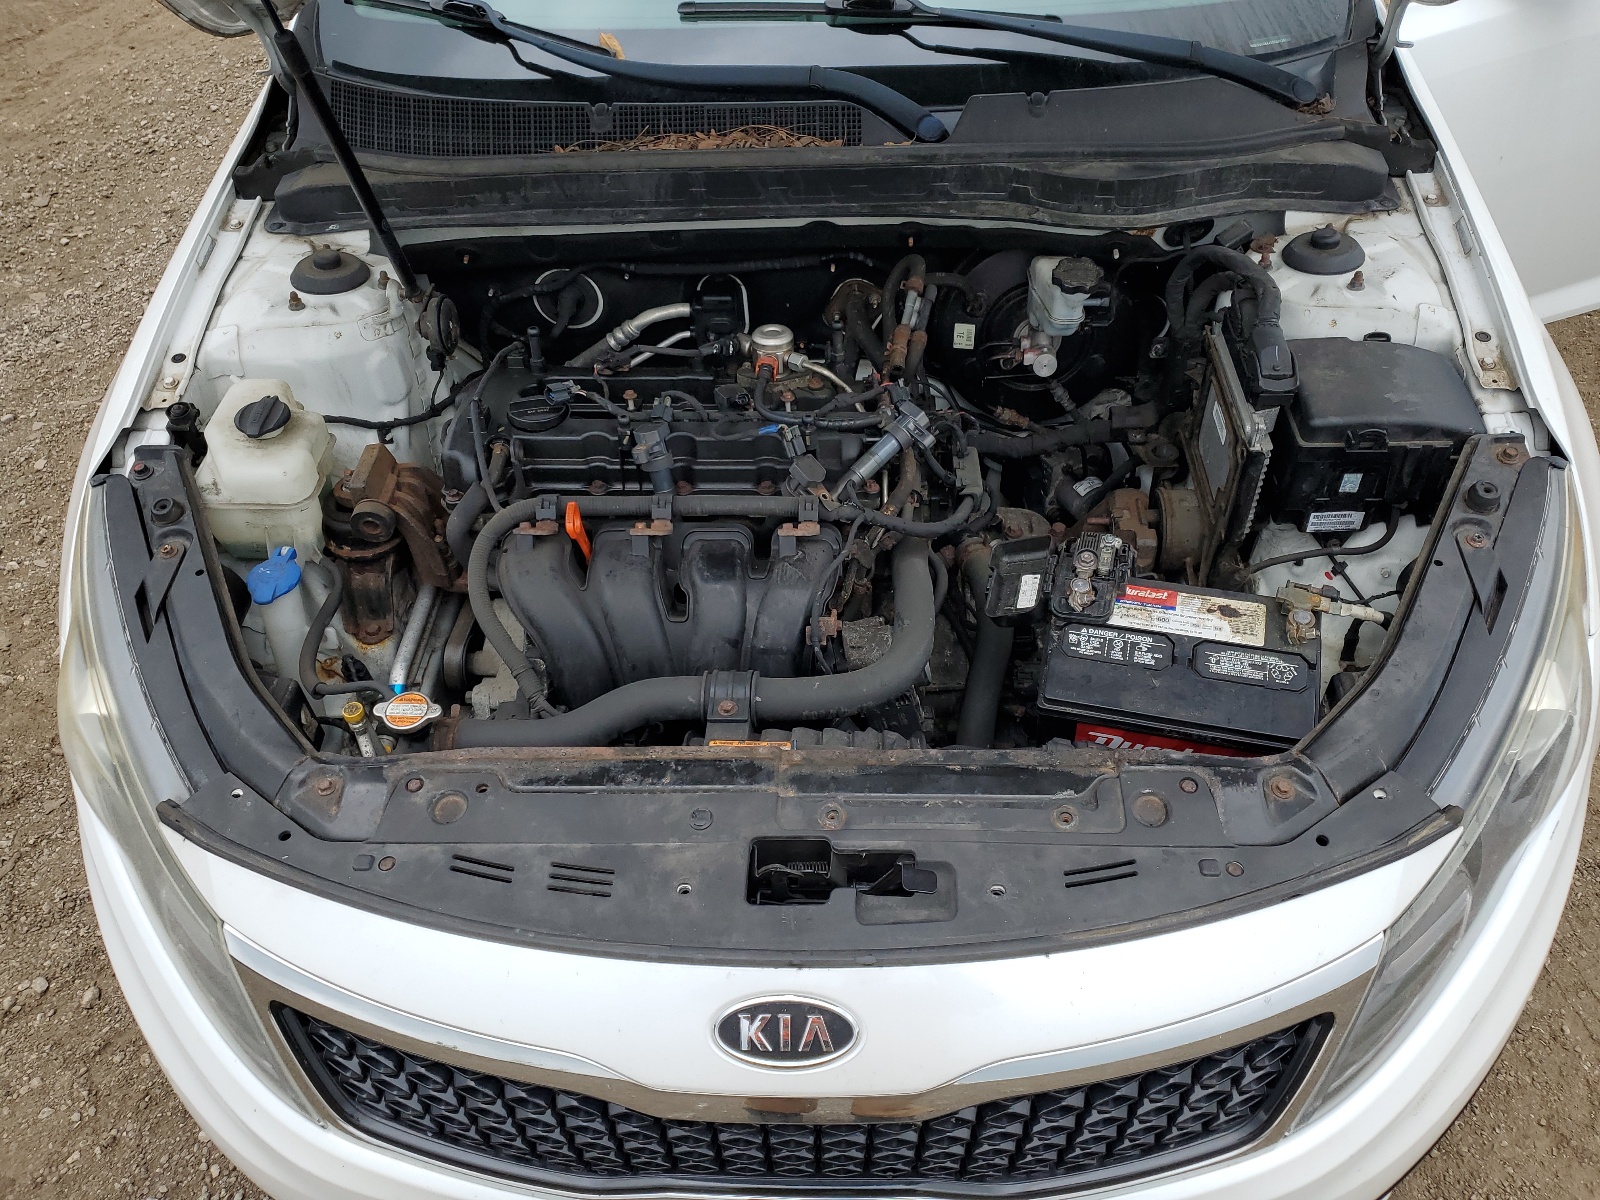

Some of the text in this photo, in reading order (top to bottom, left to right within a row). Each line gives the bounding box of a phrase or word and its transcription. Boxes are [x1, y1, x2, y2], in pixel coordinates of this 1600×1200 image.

[1088, 628, 1118, 638] DANGER
[1125, 633, 1153, 643] POISON
[738, 1013, 835, 1053] KIA
